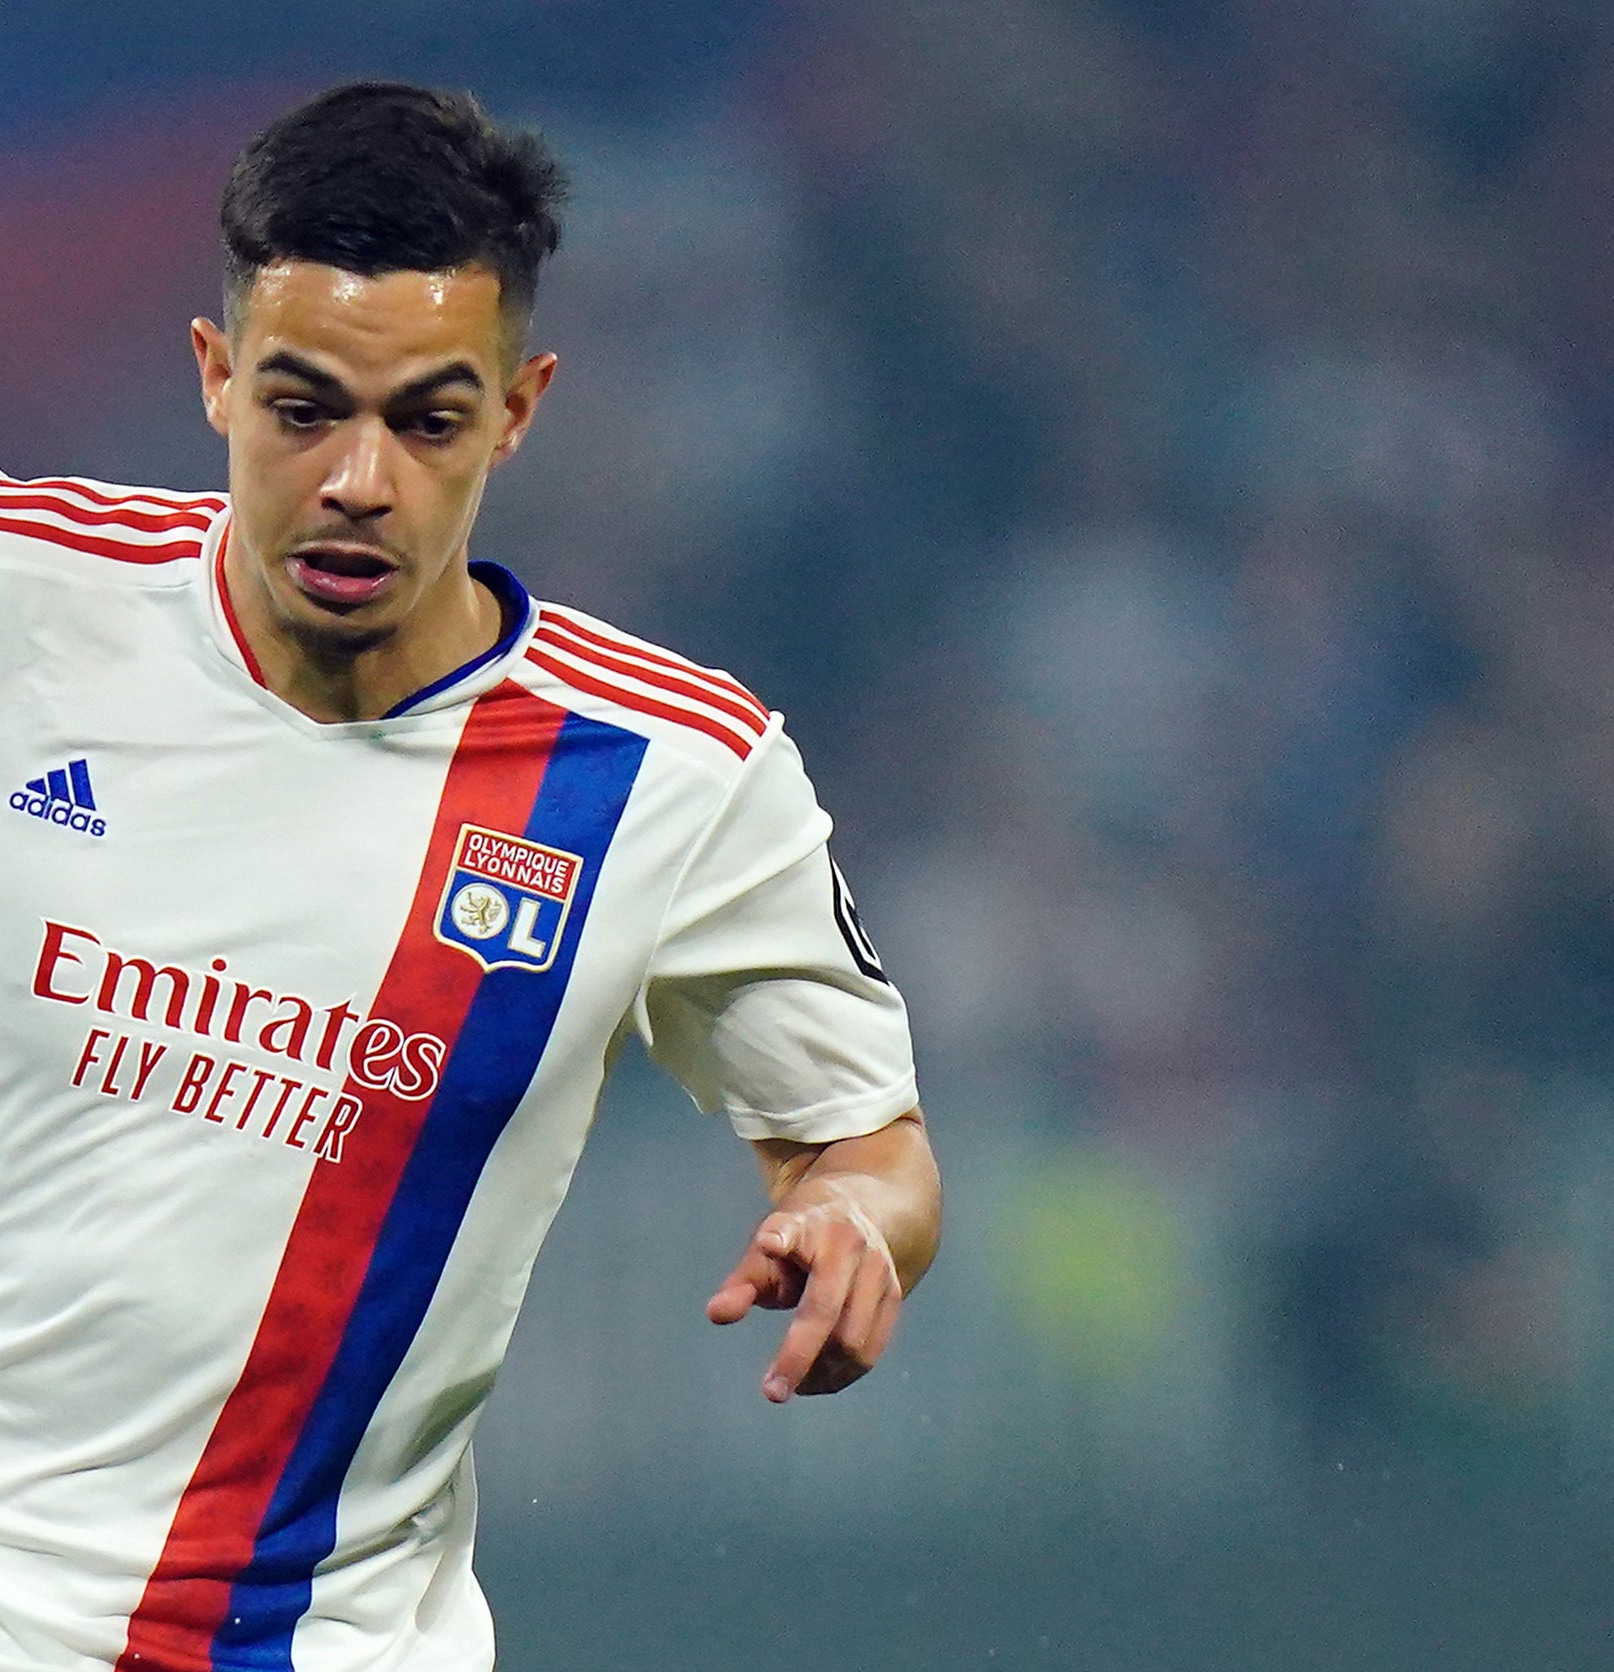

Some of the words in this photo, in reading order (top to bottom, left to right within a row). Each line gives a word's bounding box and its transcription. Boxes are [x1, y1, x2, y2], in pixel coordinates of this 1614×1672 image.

[10, 792, 106, 837] adidas
[464, 849, 565, 893] LYONNAIS
[469, 834, 569, 878] OLYMPIQUE
[31, 917, 447, 1100] Emirates
[70, 1027, 168, 1102] FLY
[170, 1051, 364, 1163] BETTER
